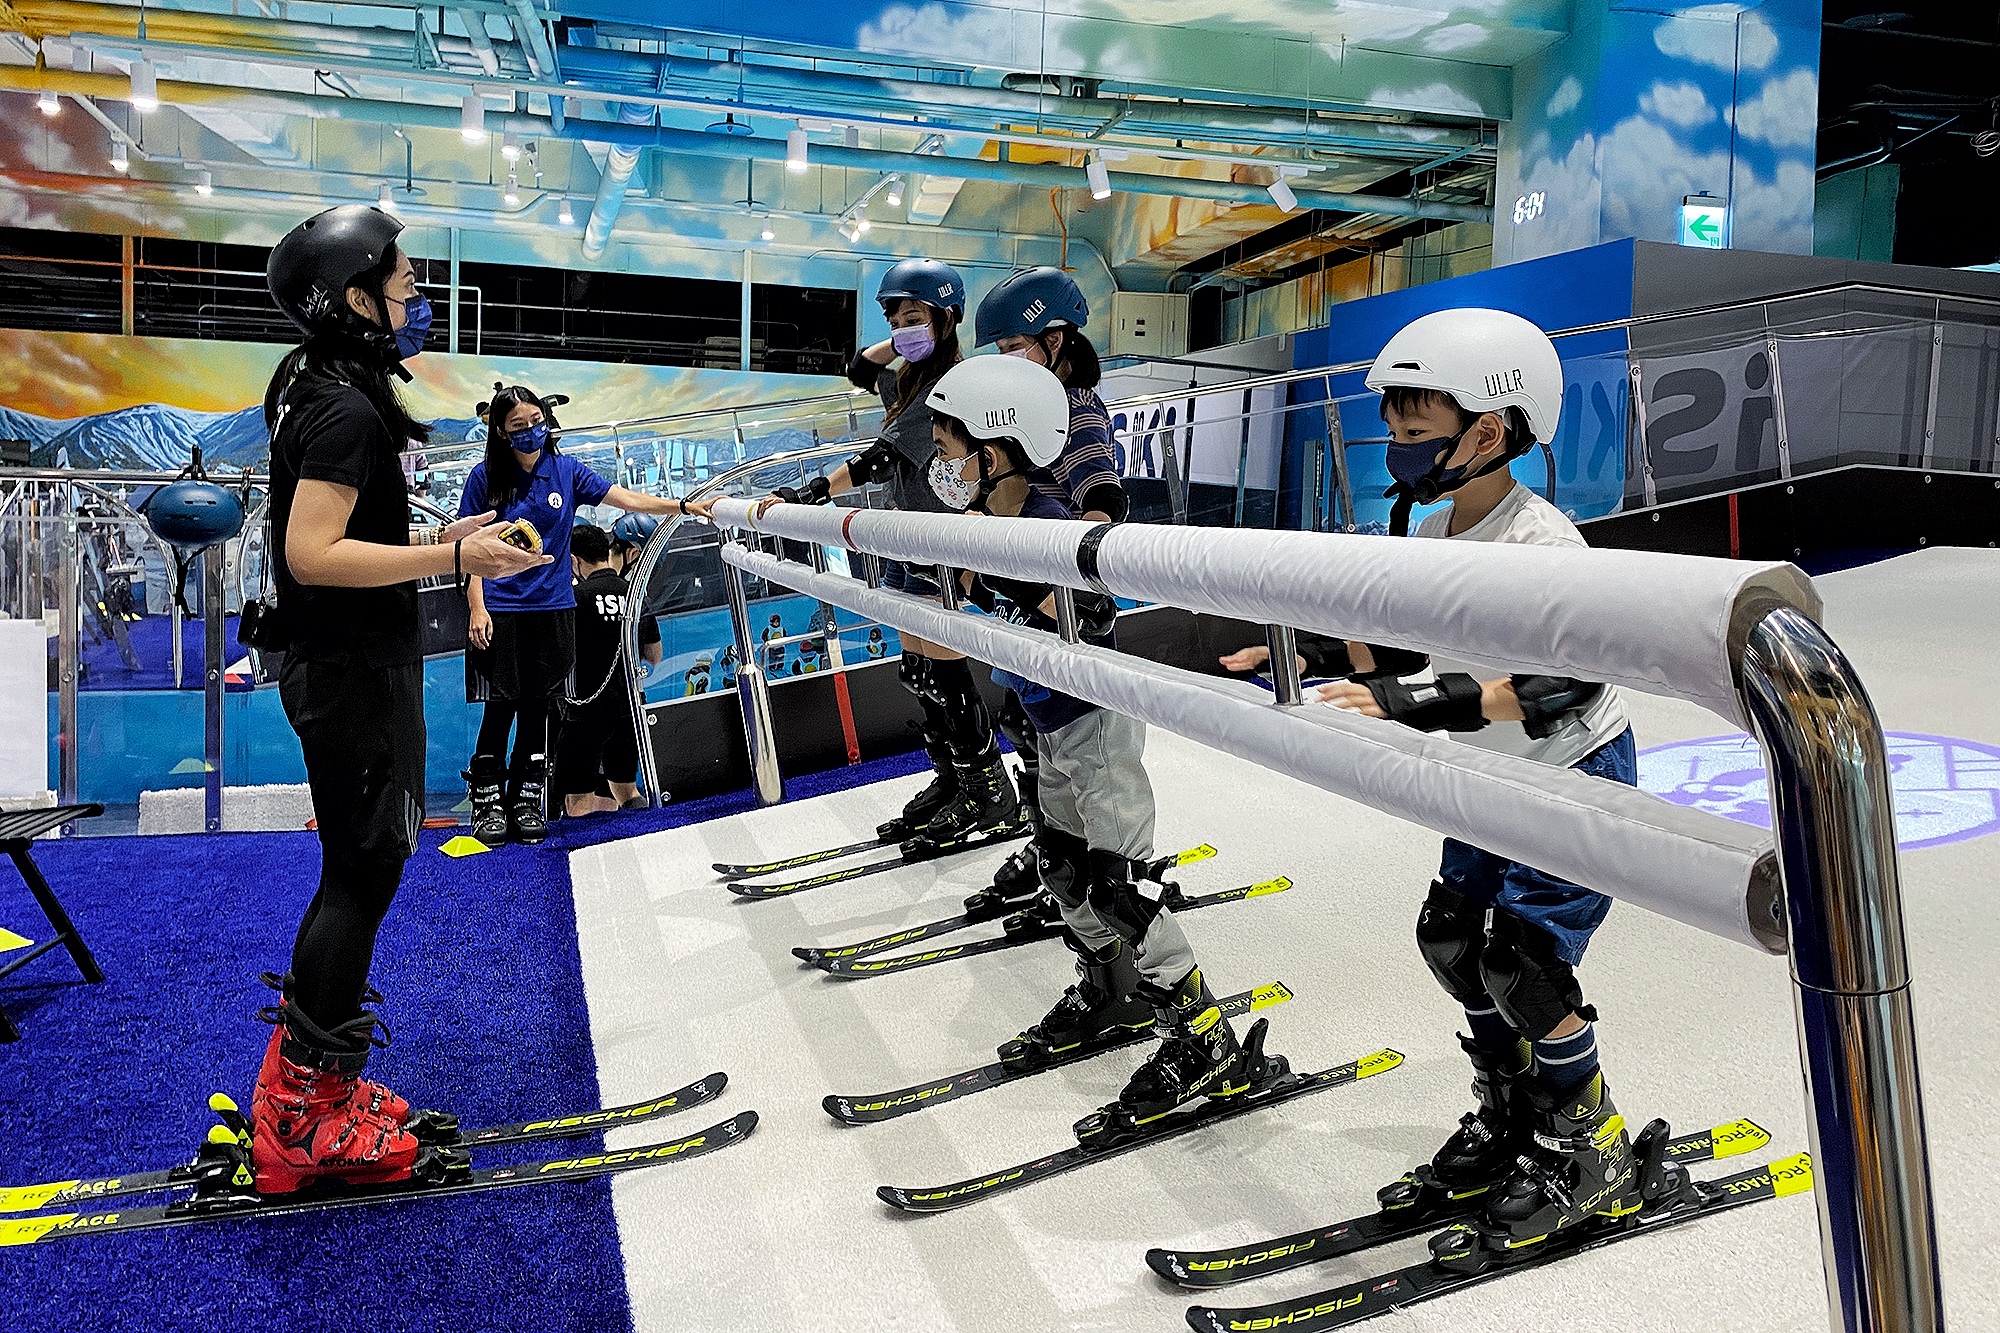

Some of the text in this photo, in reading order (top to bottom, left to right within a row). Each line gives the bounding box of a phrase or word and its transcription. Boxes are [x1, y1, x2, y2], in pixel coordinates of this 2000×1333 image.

[937, 282, 955, 299] ULLR
[1022, 298, 1047, 323] ULLR
[1485, 368, 1525, 398] ULLR
[985, 406, 1018, 429] ULLR
[824, 927, 928, 958] FISCHER
[850, 946, 964, 971] FISCHER
[1176, 1052, 1238, 1105] FISCHER
[853, 1083, 954, 1112] FISCHER
[522, 1096, 678, 1133] FISCHER
[539, 1136, 707, 1173] FISCHER
[1664, 1137, 1711, 1156] RACE
[912, 1169, 1024, 1201] FISCHER
[1556, 1167, 1632, 1229] FSCHER
[1721, 1175, 1772, 1196] RACE
[1186, 1238, 1316, 1272] FISCHER
[1229, 1291, 1364, 1332] FISCHER
